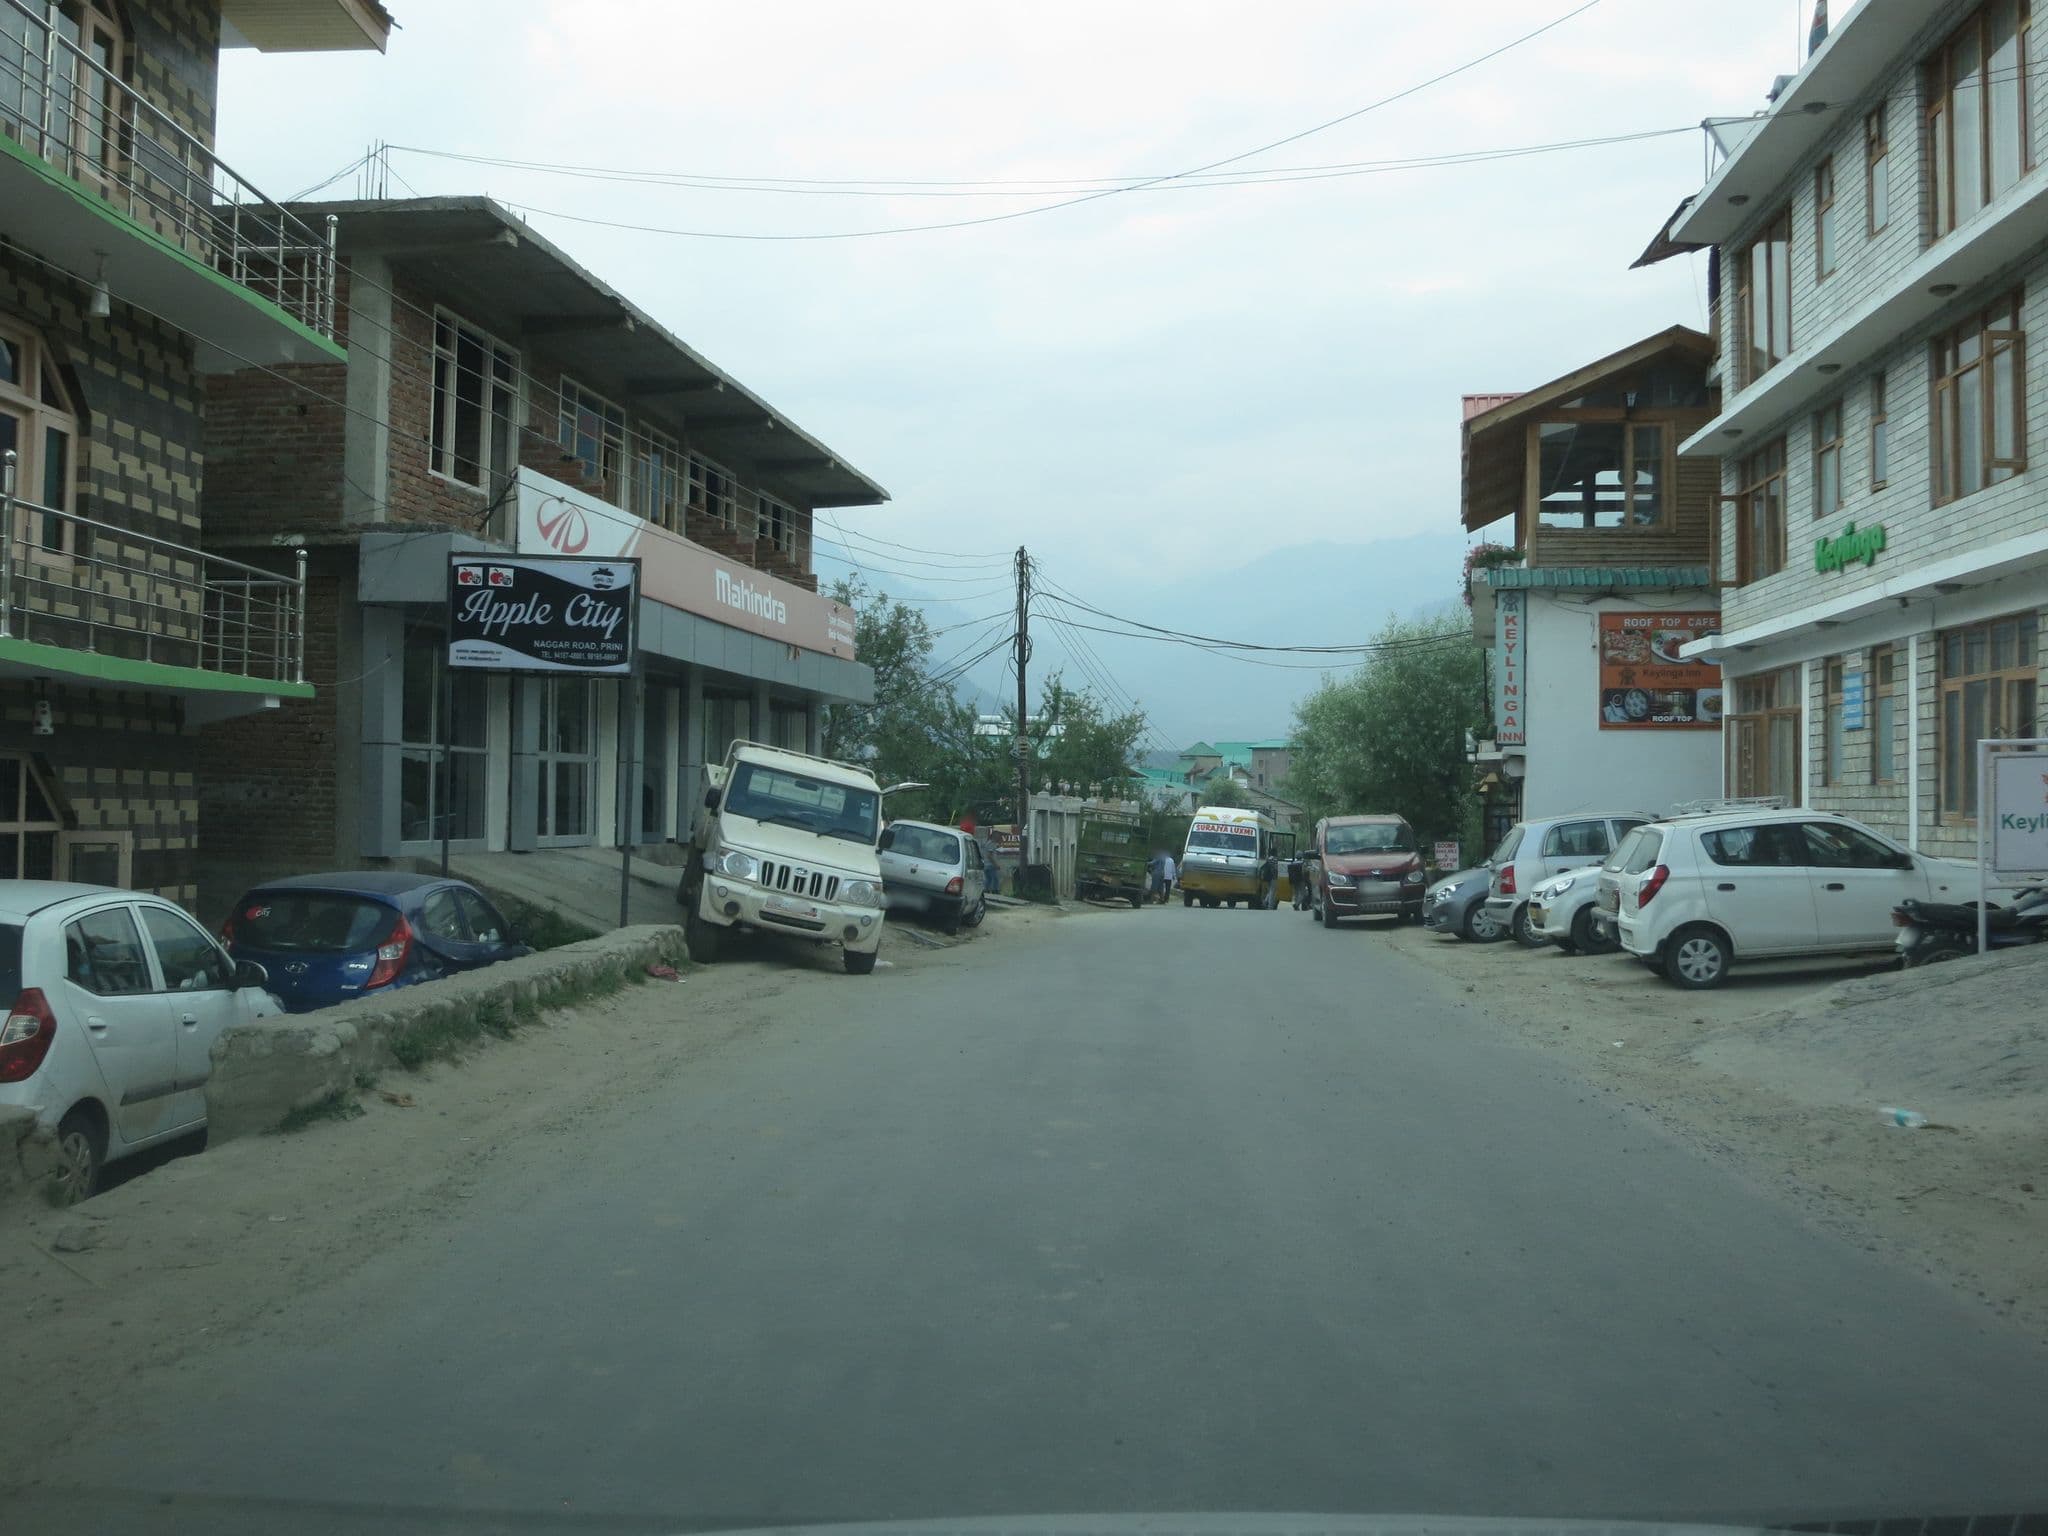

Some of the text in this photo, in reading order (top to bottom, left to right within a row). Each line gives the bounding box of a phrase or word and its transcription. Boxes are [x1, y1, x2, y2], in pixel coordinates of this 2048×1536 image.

[715, 568, 787, 625] Mahindra
[457, 589, 624, 640] Apple City
[1624, 618, 1716, 627] ROOF TOP CAFE
[534, 640, 570, 649] NAGGAR
[600, 642, 623, 651] PRINI
[1504, 615, 1518, 727] KEYLINGA
[1498, 732, 1523, 742] INN
